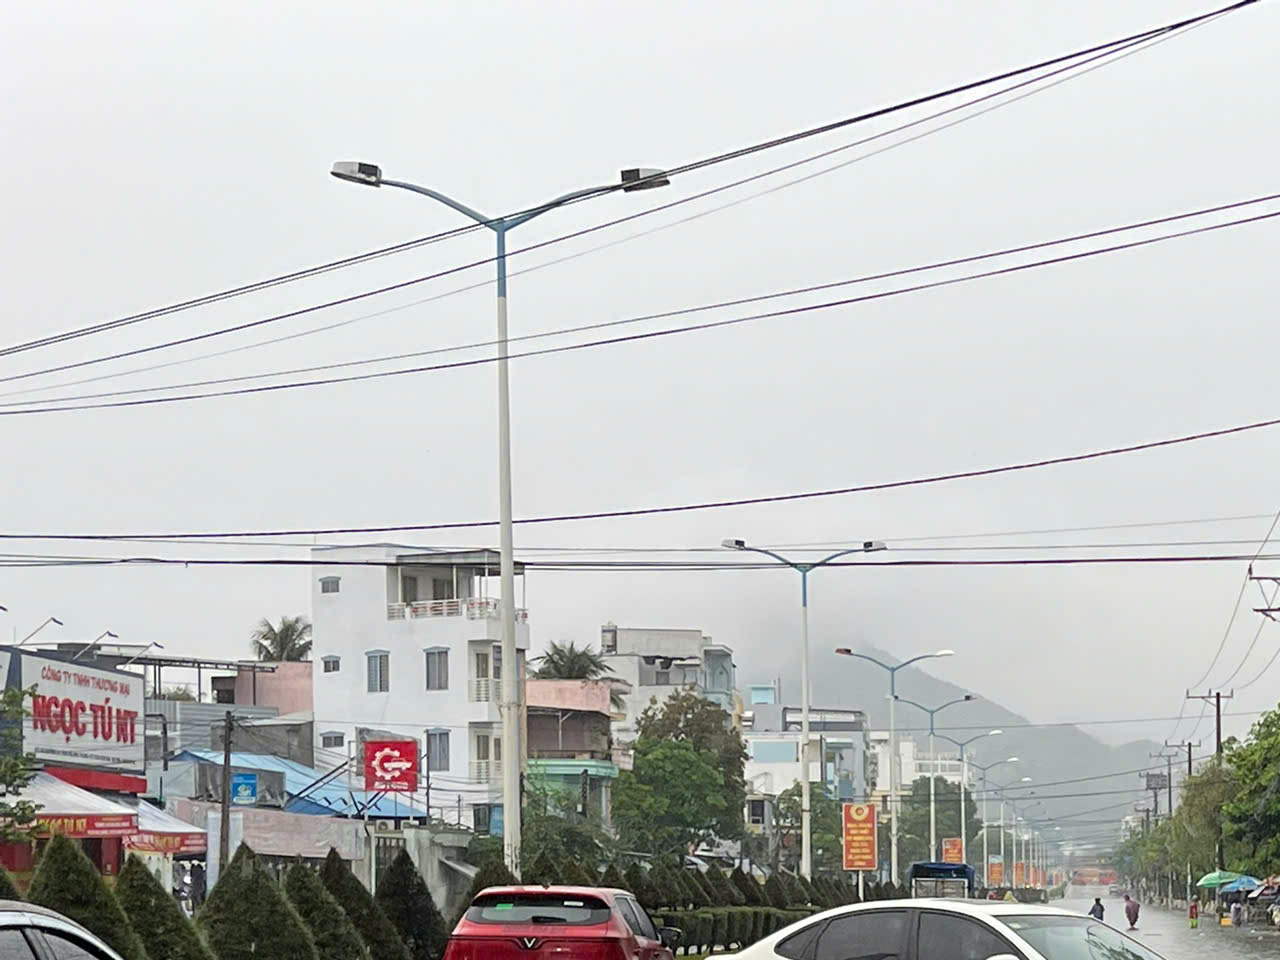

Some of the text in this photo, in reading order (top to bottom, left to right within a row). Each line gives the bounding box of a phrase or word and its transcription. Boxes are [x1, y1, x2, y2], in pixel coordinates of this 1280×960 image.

[41, 665, 62, 682] CÔNG
[62, 670, 74, 684] TY
[32, 694, 88, 744] NGỌC
[89, 697, 113, 741] TÚ
